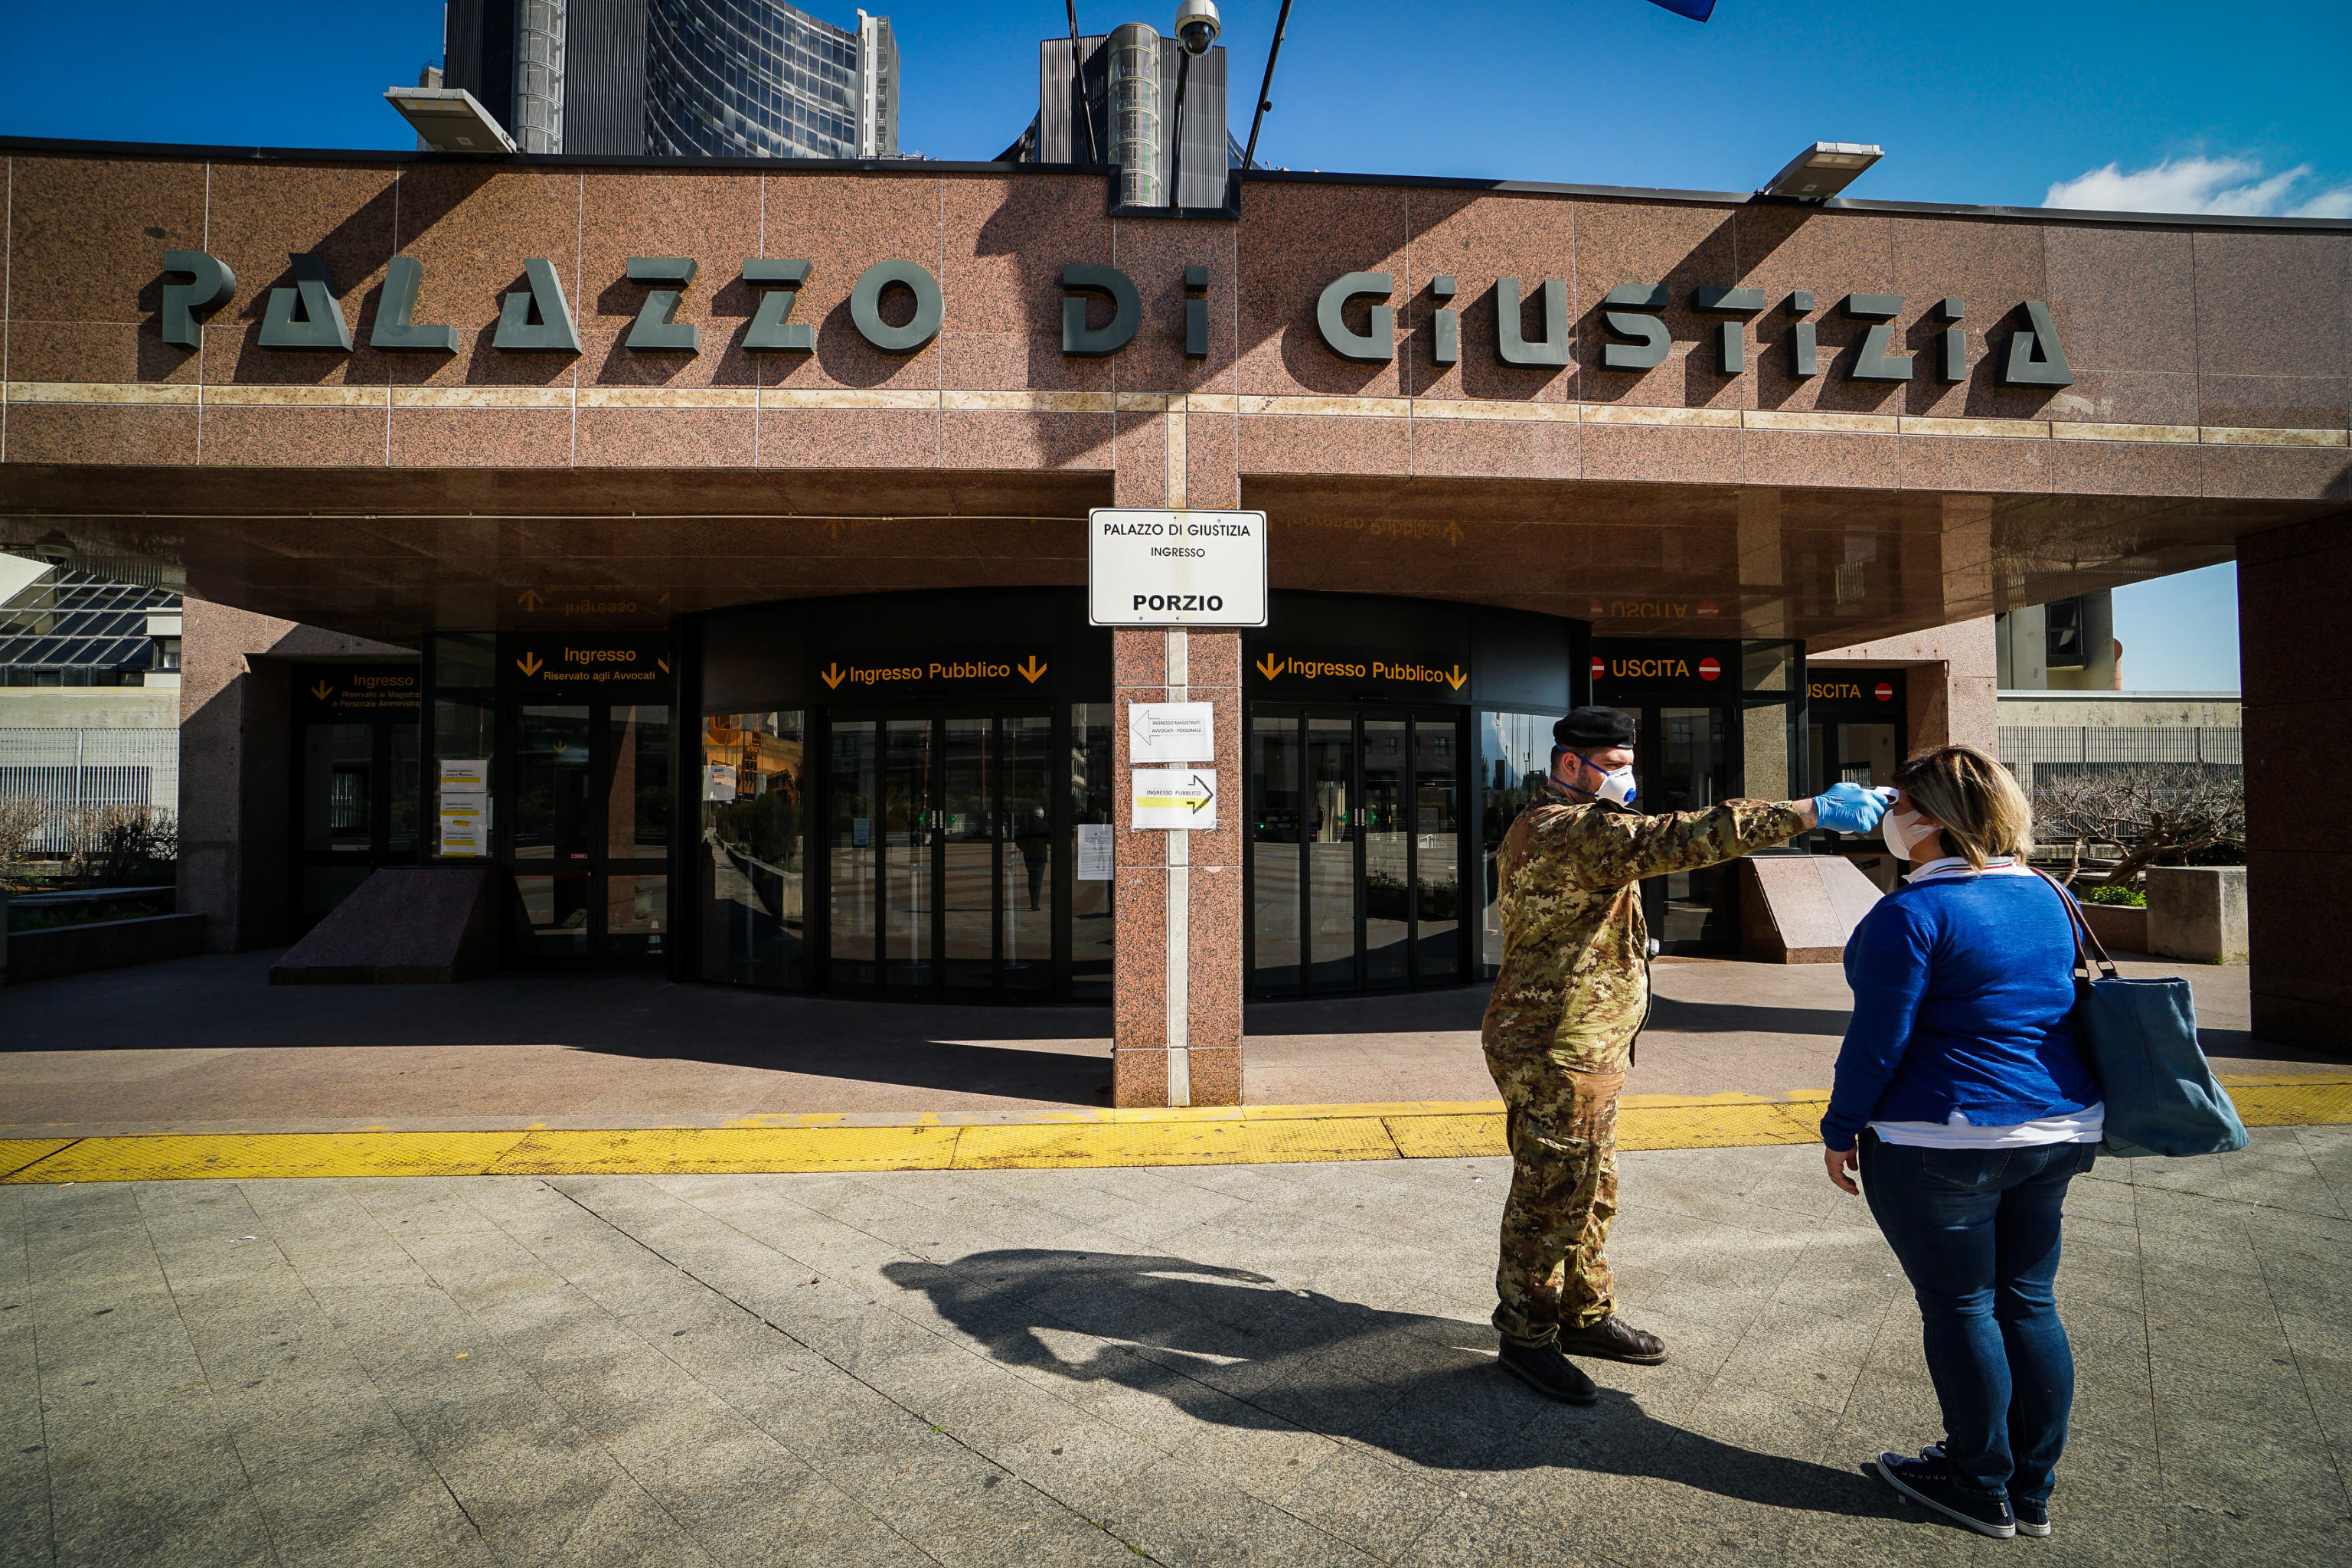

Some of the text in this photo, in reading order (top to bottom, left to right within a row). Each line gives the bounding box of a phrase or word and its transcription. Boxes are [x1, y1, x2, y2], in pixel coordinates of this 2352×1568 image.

[162, 250, 946, 354] PALAZZO
[1103, 523, 1251, 537] PALAZZO DI GIUSTIZIA
[1150, 547, 1206, 557] INGRESSO
[1132, 594, 1223, 612] PORZIO
[564, 646, 637, 665] Ingresso
[544, 671, 655, 682] Riservato agli Avvocati
[850, 662, 1011, 685] Ingresso Pubblico
[1288, 657, 1444, 683] Ingresso Pubblico
[1612, 659, 1690, 678] USCITA
[354, 674, 414, 688] Ingresso
[387, 691, 420, 699] Magistra
